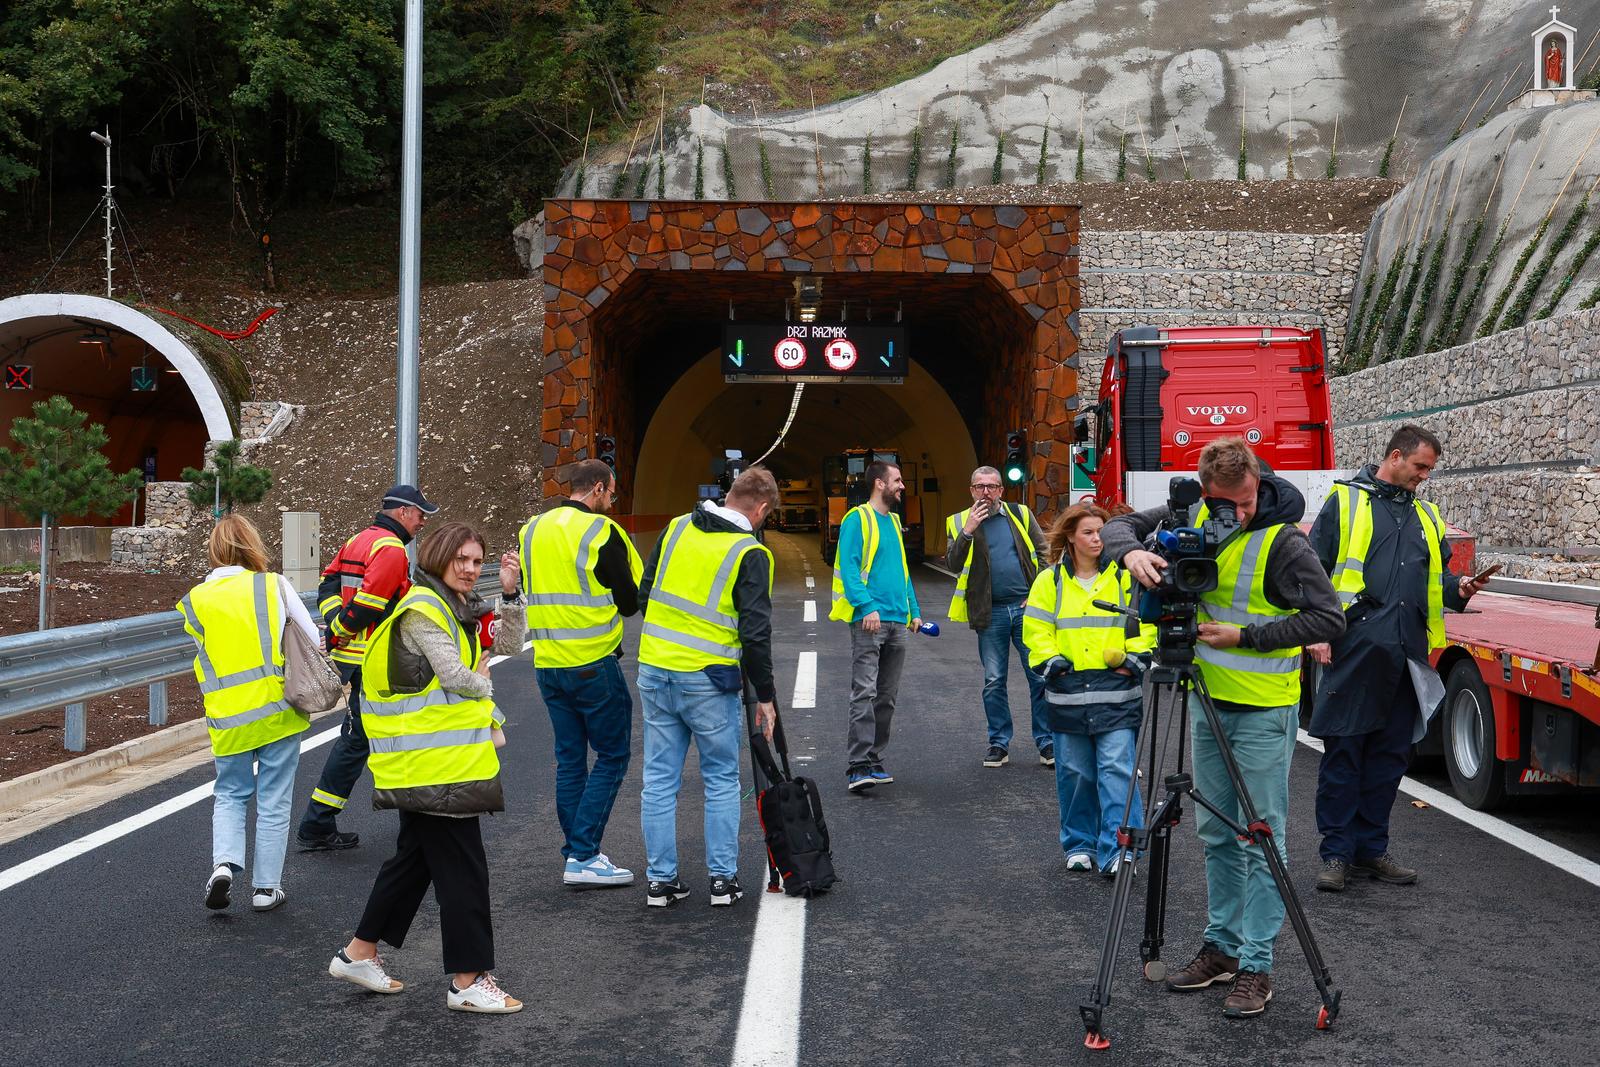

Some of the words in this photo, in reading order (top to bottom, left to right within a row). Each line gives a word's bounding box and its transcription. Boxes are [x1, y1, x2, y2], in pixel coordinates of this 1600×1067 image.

[812, 326, 847, 338] RAZMAK
[782, 347, 799, 360] 60
[1186, 405, 1247, 415] VOLVO
[1213, 415, 1222, 423] HR
[1179, 434, 1188, 442] 70
[1249, 432, 1258, 440] 80
